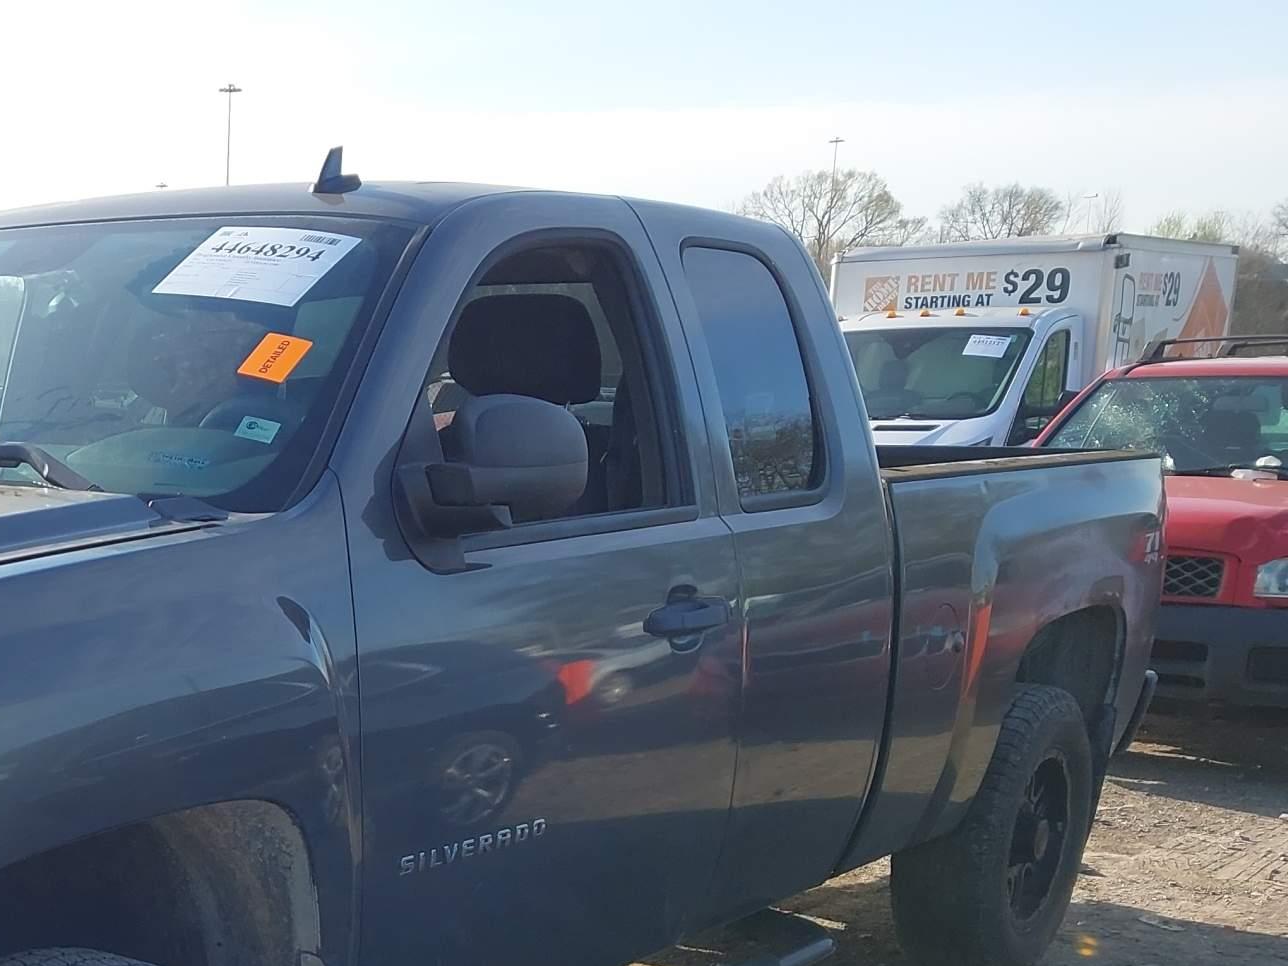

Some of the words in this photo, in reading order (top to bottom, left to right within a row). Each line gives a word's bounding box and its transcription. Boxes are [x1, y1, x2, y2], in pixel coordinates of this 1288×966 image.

[211, 240, 326, 262] 44648294
[906, 273, 959, 293] RENT
[965, 271, 998, 291] ME
[1002, 266, 1071, 305] $29
[1162, 271, 1181, 307] $29
[904, 294, 971, 310] STARTING
[974, 293, 994, 307] AT
[258, 340, 290, 374] DETAILED
[399, 818, 547, 876] SILVERADO
